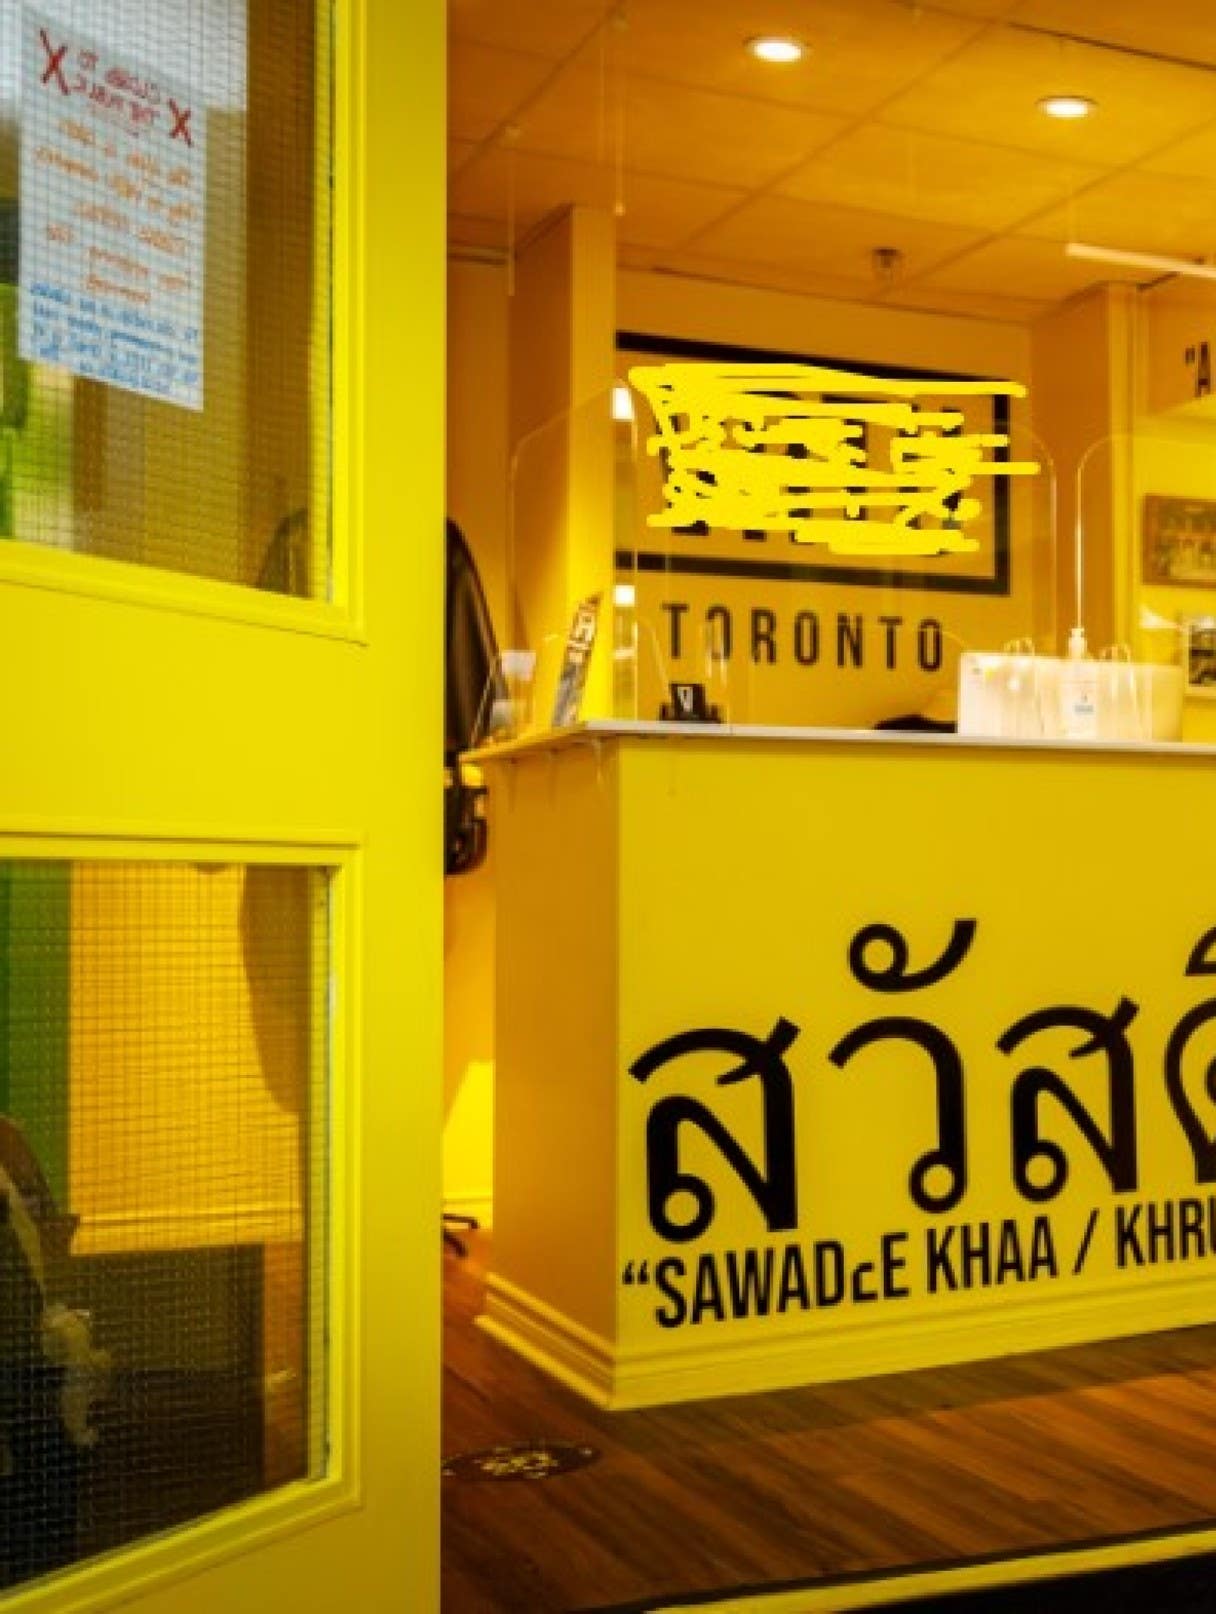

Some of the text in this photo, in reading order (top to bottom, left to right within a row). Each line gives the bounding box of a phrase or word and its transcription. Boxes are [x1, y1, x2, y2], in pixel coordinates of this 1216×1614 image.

[661, 602, 944, 673] TORONTO
[926, 1214, 1058, 1294] KHAA
[1073, 1209, 1100, 1274] /
